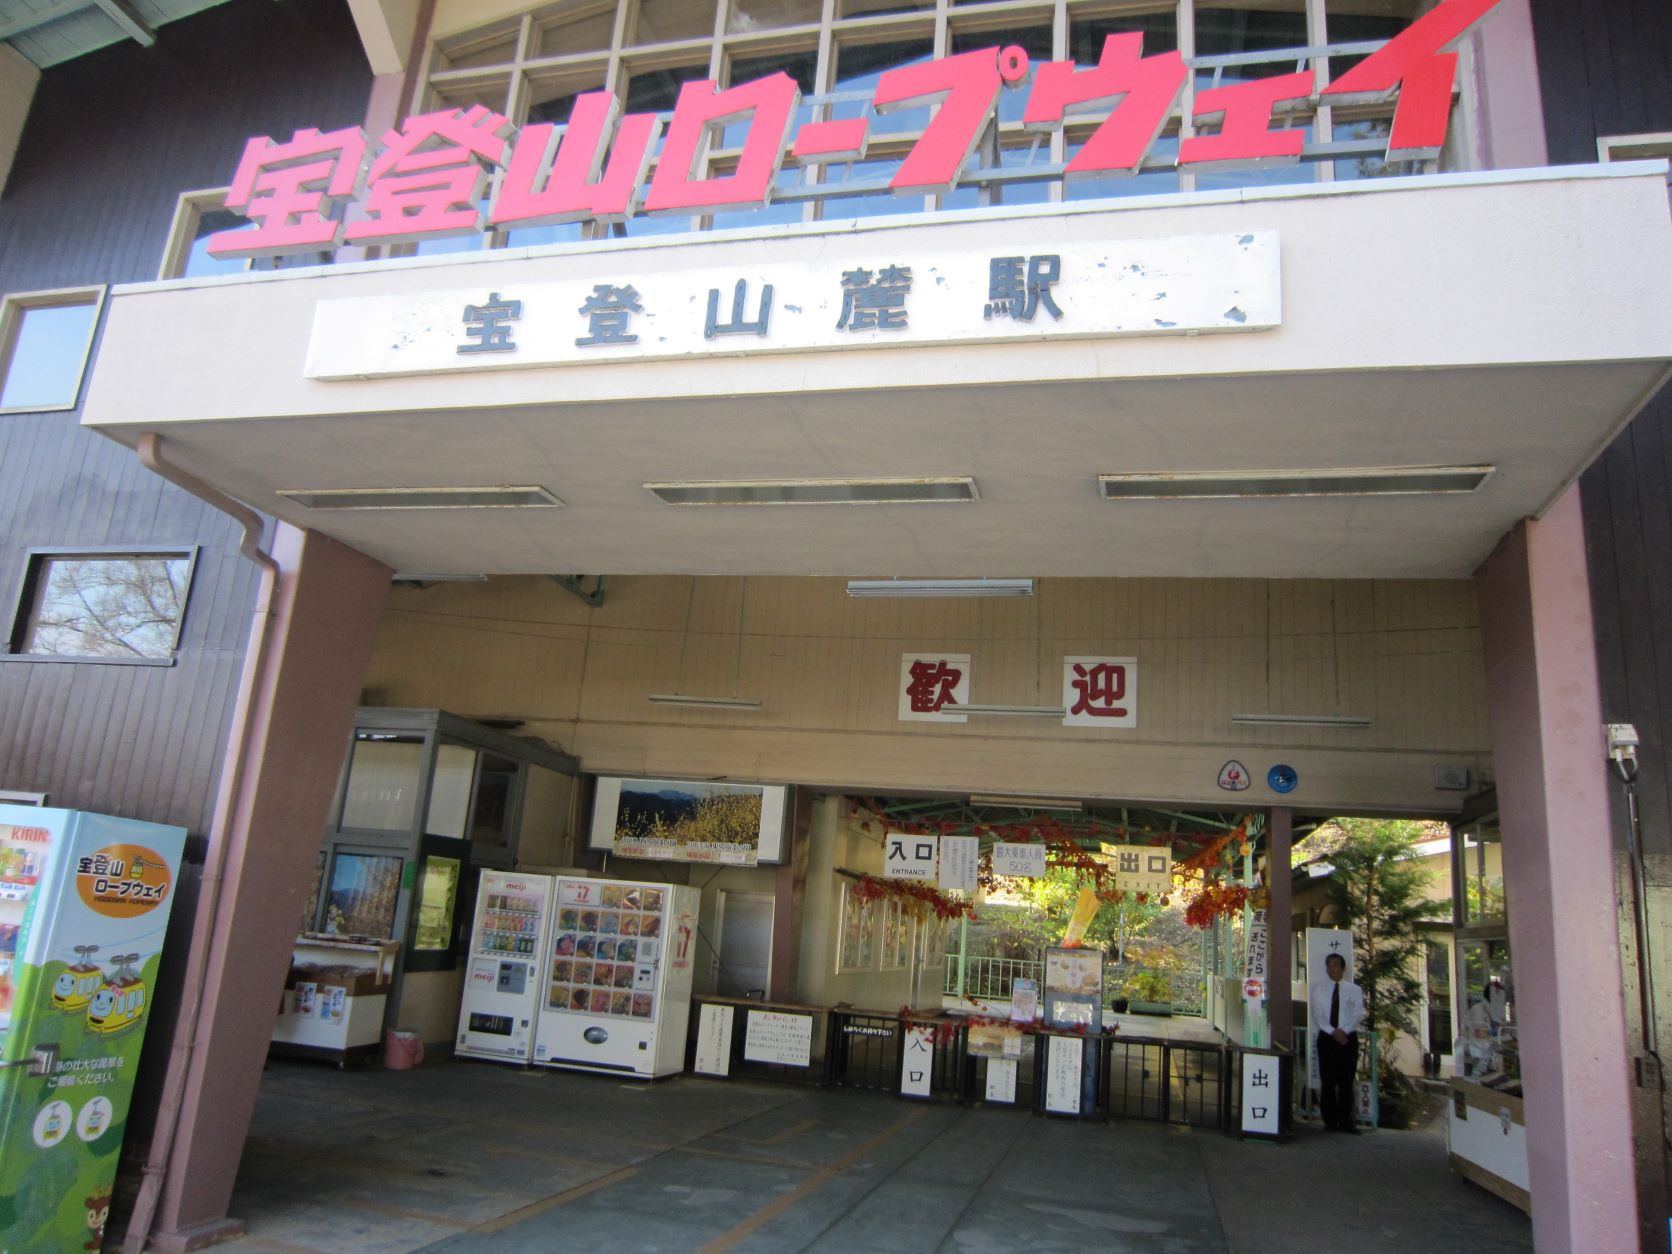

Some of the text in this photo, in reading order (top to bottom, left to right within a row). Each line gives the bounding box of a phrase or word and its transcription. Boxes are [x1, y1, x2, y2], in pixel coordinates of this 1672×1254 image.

[207, 0, 1500, 258] 宝登山ロープウェイ
[457, 254, 1063, 355] 宝登山麓駅
[11, 827, 51, 842] KIRIN
[888, 841, 933, 861] 入口
[77, 854, 125, 878] 宝登山
[891, 868, 926, 876] ENTRANCE
[1119, 852, 1167, 873] 出口
[506, 882, 527, 891] meiji
[909, 1038, 928, 1083] 入口
[1252, 1068, 1269, 1120] 出口
